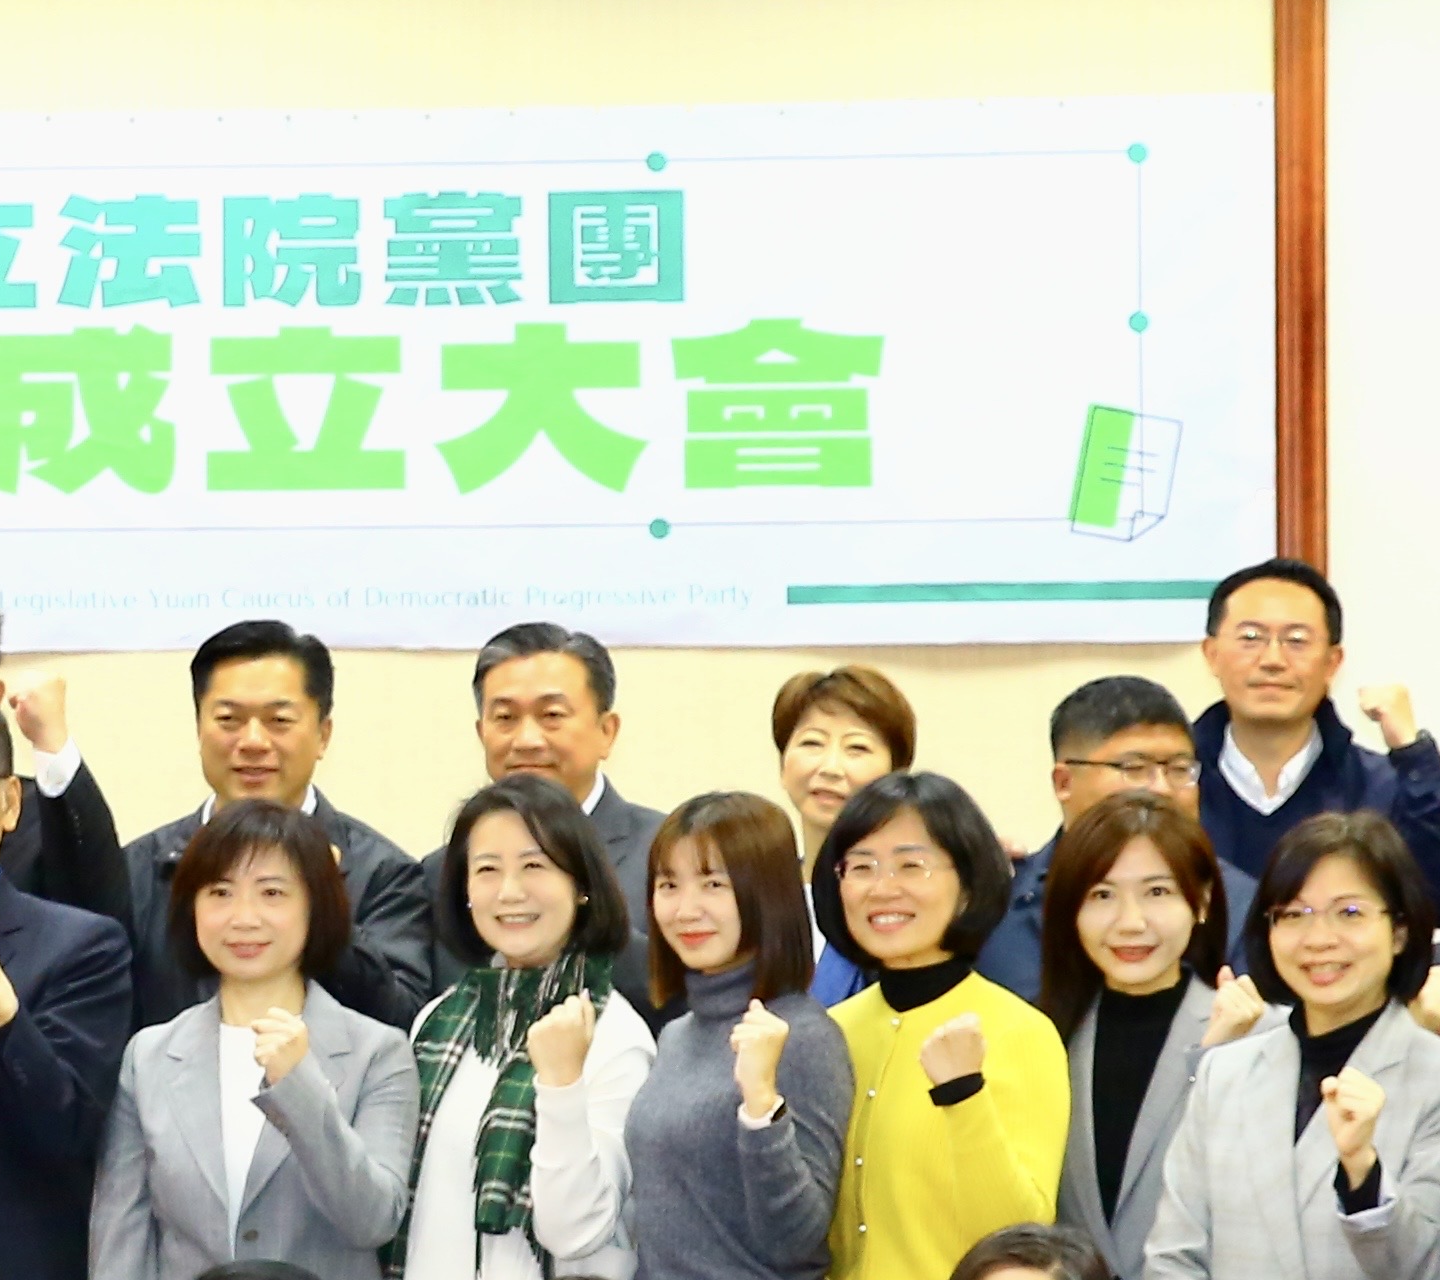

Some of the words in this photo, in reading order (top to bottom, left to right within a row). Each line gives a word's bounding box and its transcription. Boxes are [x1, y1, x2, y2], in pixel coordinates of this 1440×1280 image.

[0, 587, 137, 613] Legislative
[149, 588, 210, 609] Yuan
[221, 587, 315, 609] Caucus
[326, 586, 351, 608] of
[364, 586, 513, 608] Democratic
[525, 584, 675, 612] Progressive
[688, 583, 754, 611] Party
